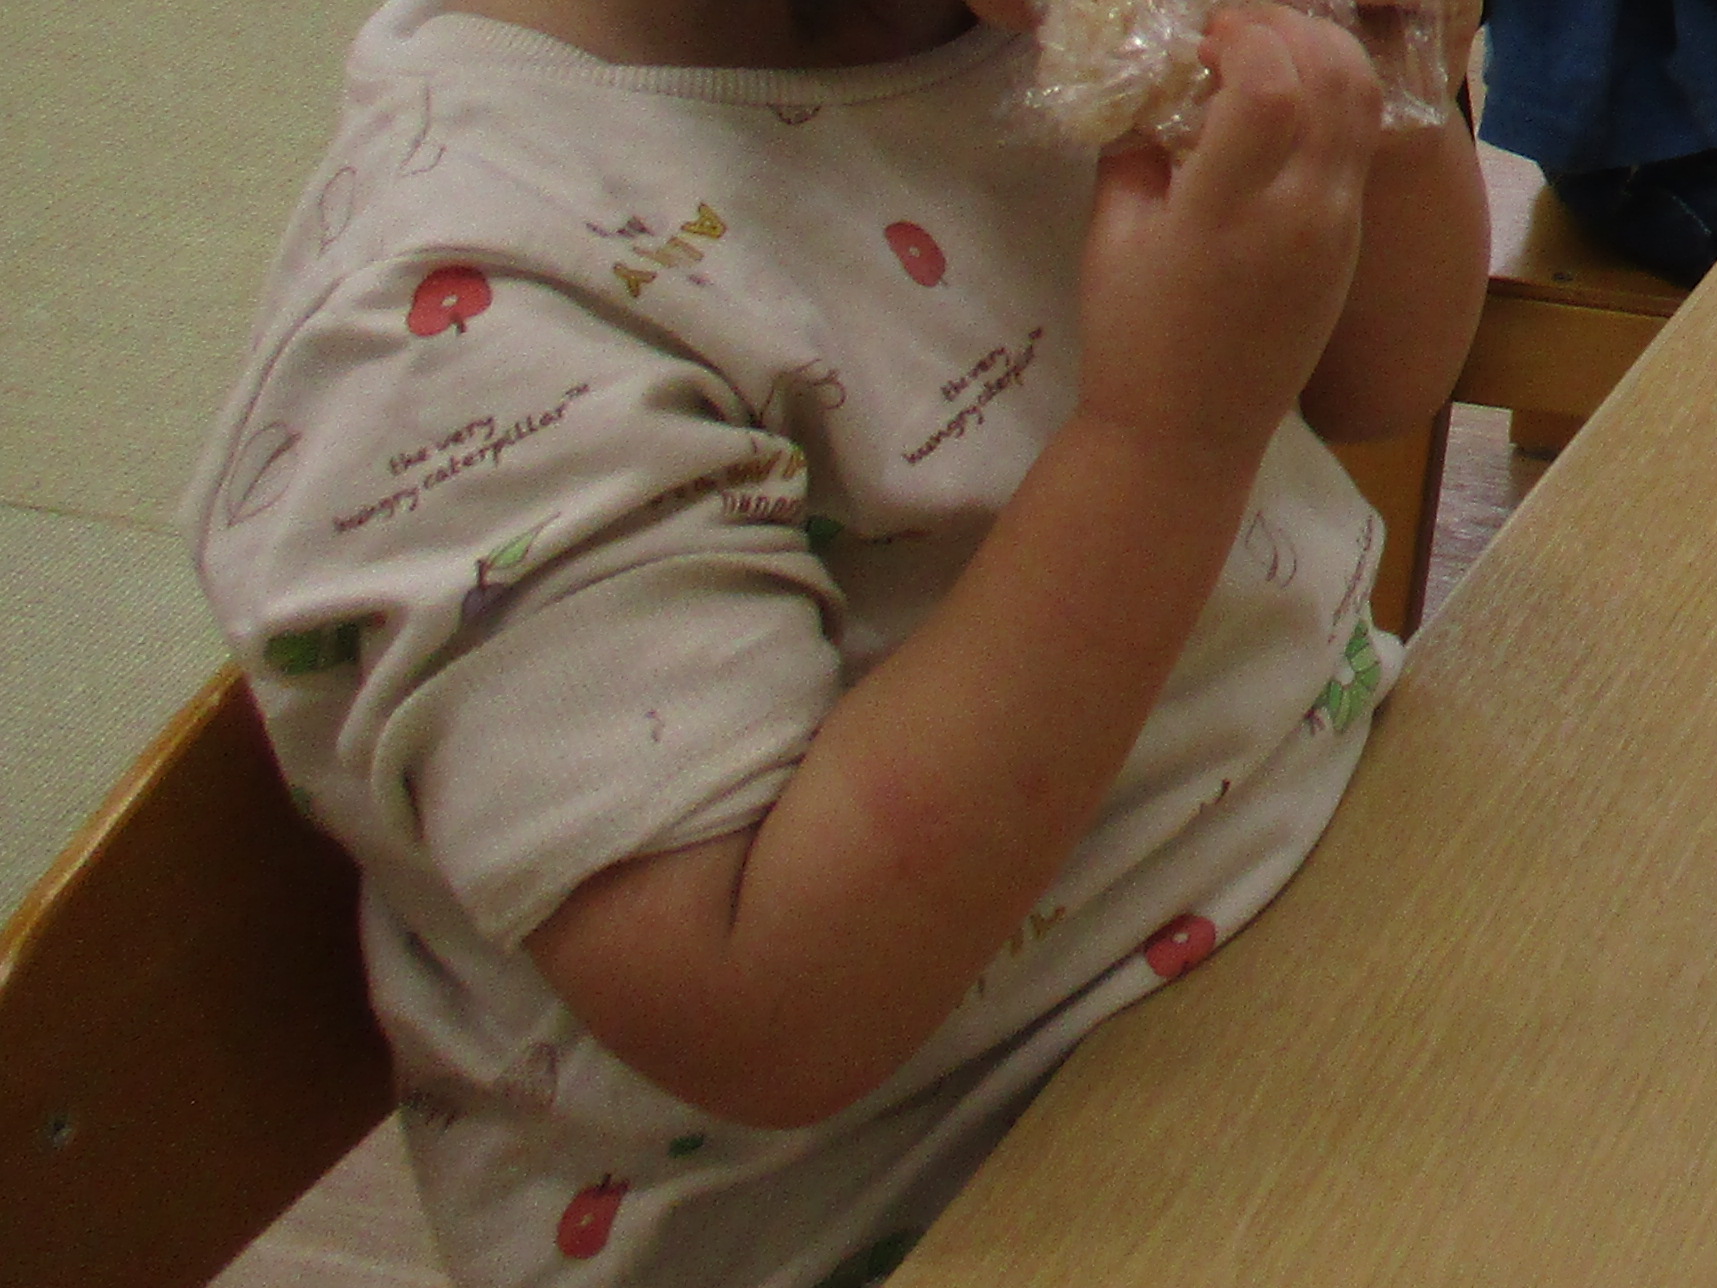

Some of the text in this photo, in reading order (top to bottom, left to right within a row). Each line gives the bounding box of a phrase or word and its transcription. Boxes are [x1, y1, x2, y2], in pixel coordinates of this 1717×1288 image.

[390, 416, 495, 476] the very
[333, 486, 420, 532] hungry
